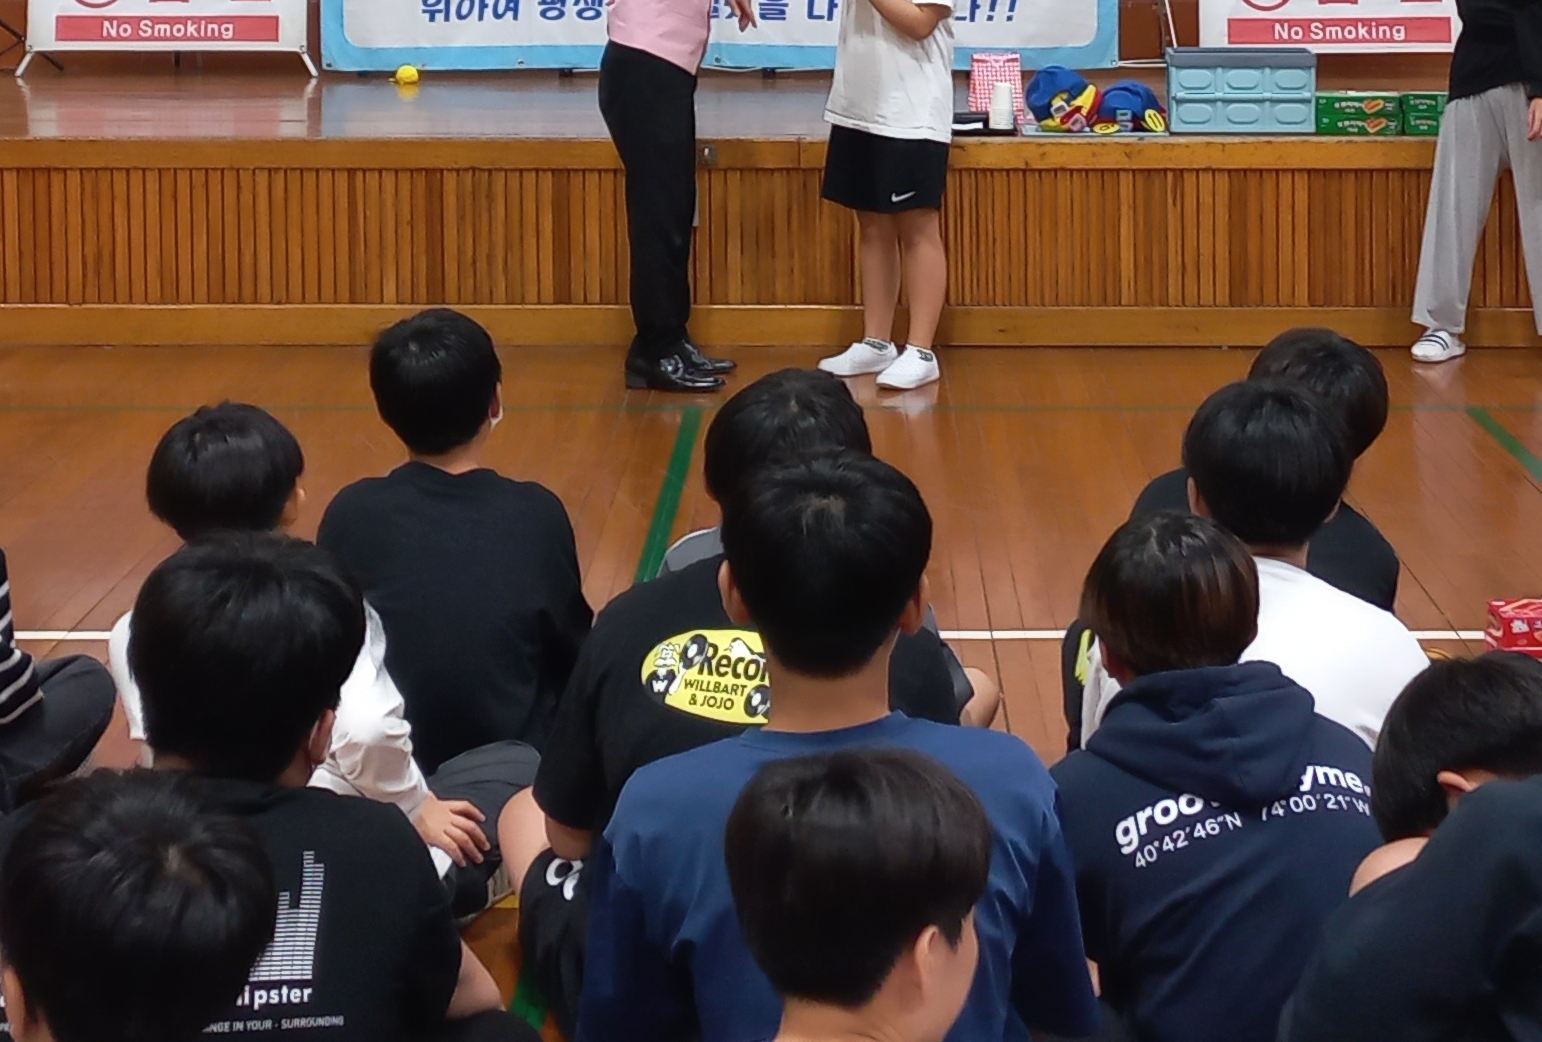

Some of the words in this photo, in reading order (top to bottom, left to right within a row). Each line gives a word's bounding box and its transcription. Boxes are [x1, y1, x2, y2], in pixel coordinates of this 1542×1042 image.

[102, 20, 132, 38] No
[138, 19, 234, 39] Smoking
[1274, 23, 1303, 40] No
[1310, 22, 1406, 41] Smoking
[684, 678, 748, 697] WILLBART
[688, 694, 698, 705] &
[700, 695, 735, 711] JOJO
[236, 984, 313, 1011] ipster
